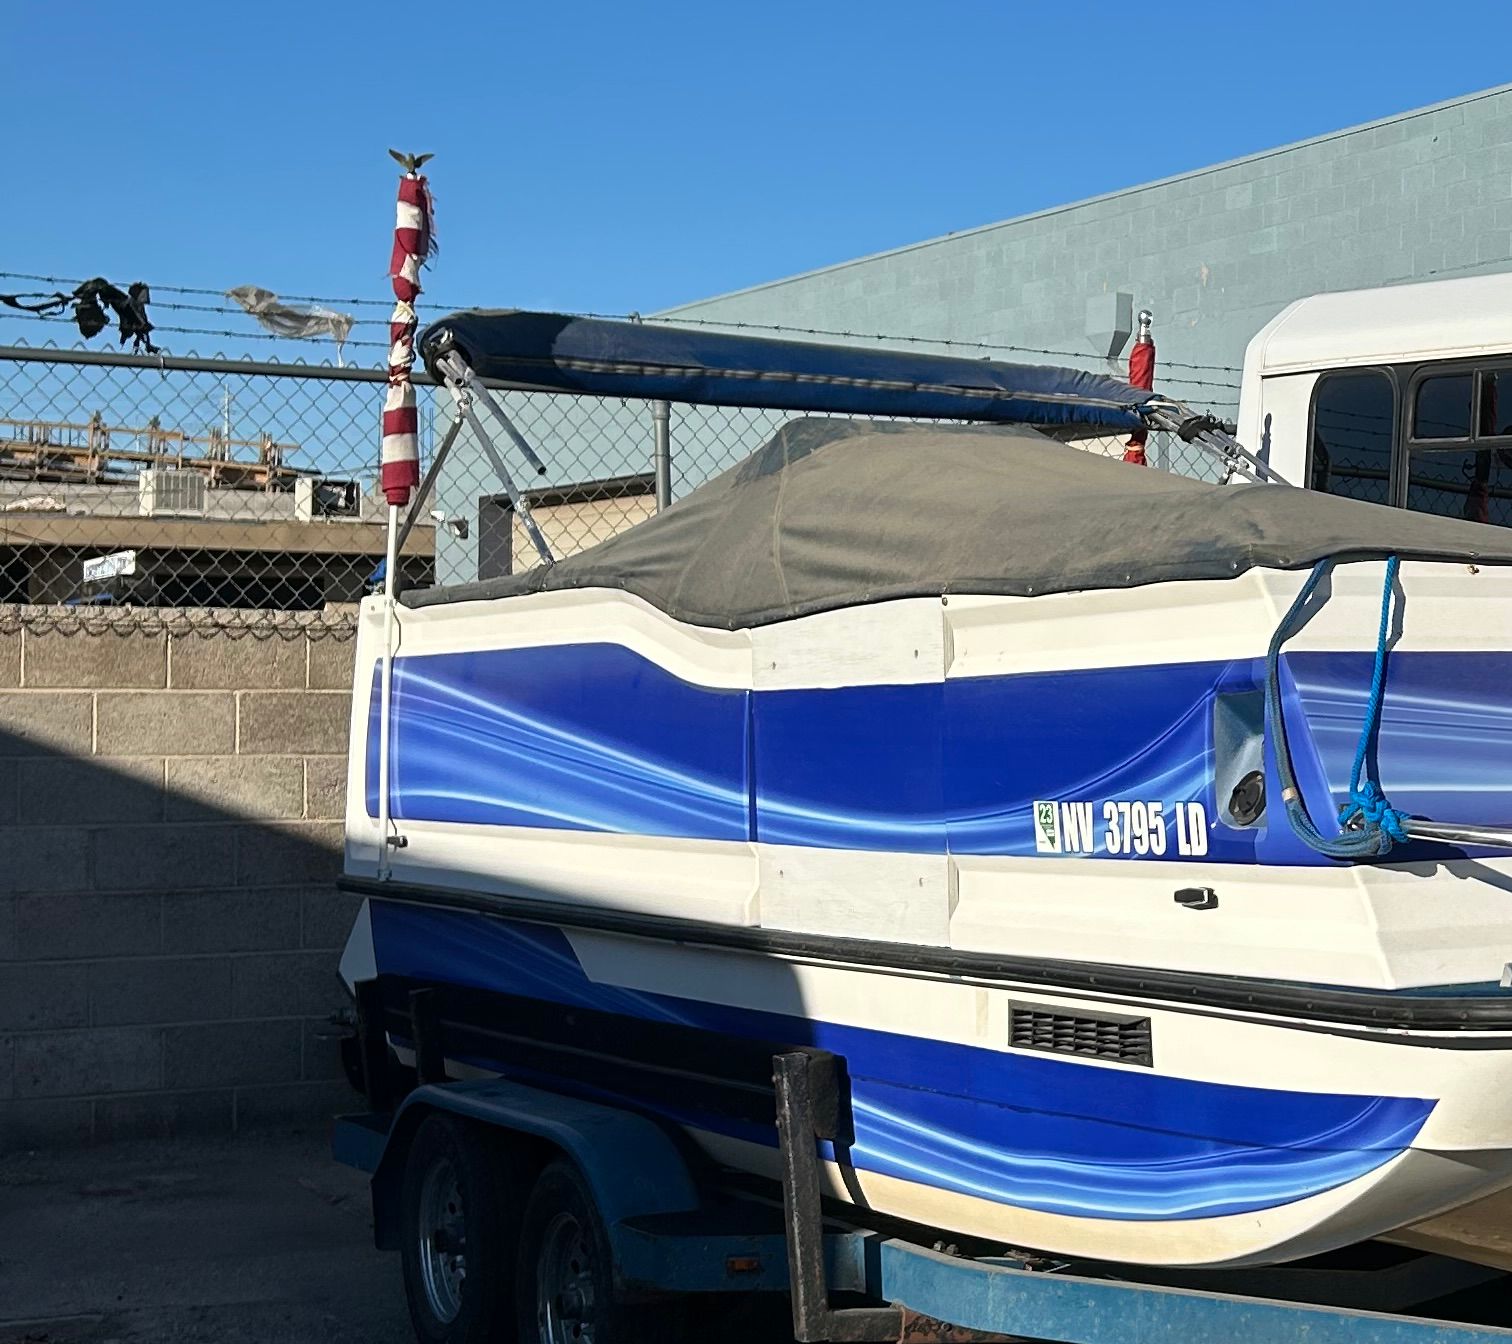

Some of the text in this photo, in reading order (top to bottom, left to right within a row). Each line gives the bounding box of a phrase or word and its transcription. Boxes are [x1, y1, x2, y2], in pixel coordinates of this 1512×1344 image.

[1039, 803, 1053, 824] 23
[1061, 801, 1208, 856] NV 3795 LD
